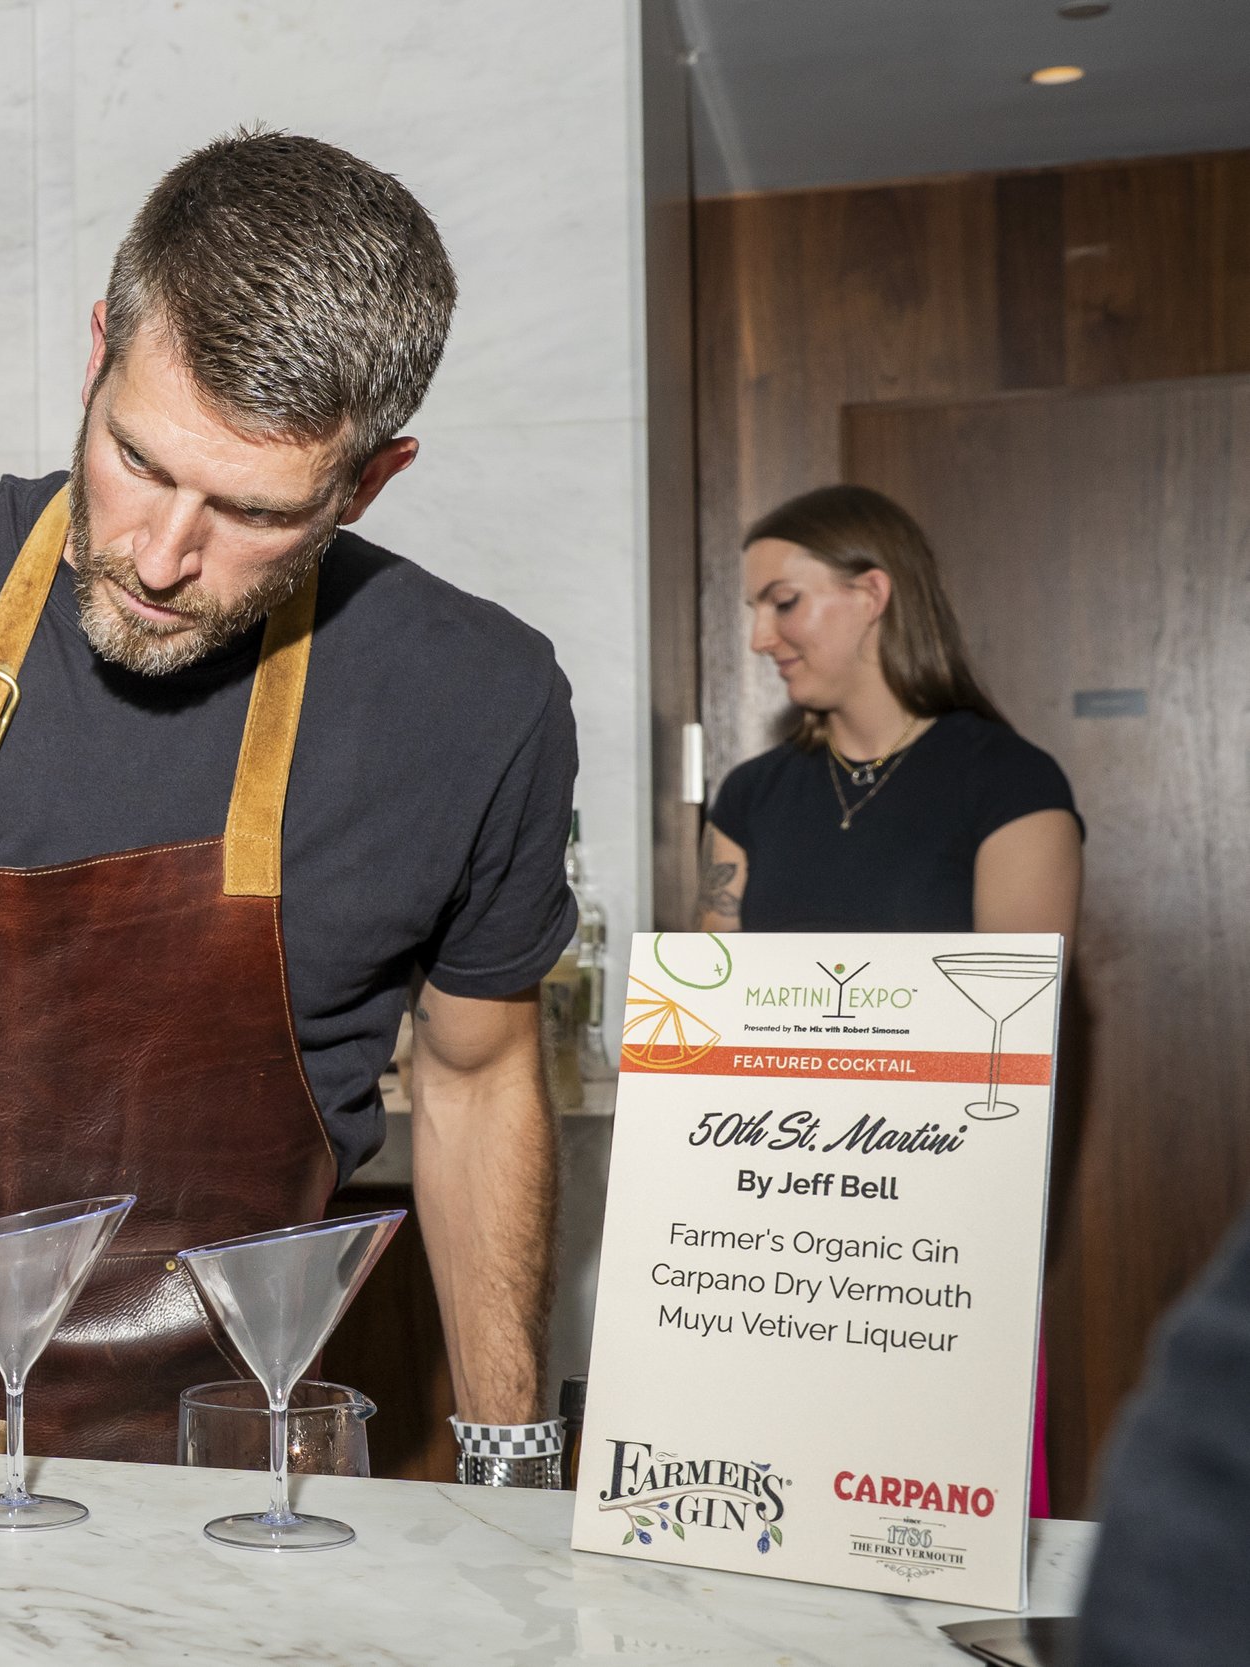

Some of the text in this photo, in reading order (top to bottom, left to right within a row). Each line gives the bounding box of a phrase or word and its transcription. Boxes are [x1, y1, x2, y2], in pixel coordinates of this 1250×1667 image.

[745, 987, 831, 1007] MARTINI
[744, 1024, 910, 1035] Presented by The Mix with Robert Simonson
[733, 1055, 916, 1073] FEATURED COCKTAIL
[689, 1110, 968, 1155] 50th St. Martini
[737, 1169, 899, 1200] By Jeff Bell
[670, 1222, 959, 1264] Farmer's Organic Gin
[651, 1263, 972, 1309] Carpano Dry Vermouth
[658, 1304, 959, 1353] Muyu Vetiver Liqueur
[833, 1470, 995, 1518] CARPANO
[675, 1495, 751, 1531] GIN
[903, 1516, 923, 1524] since
[887, 1524, 933, 1548] 1786
[851, 1541, 964, 1564] THE FIRST VERMOUTH
